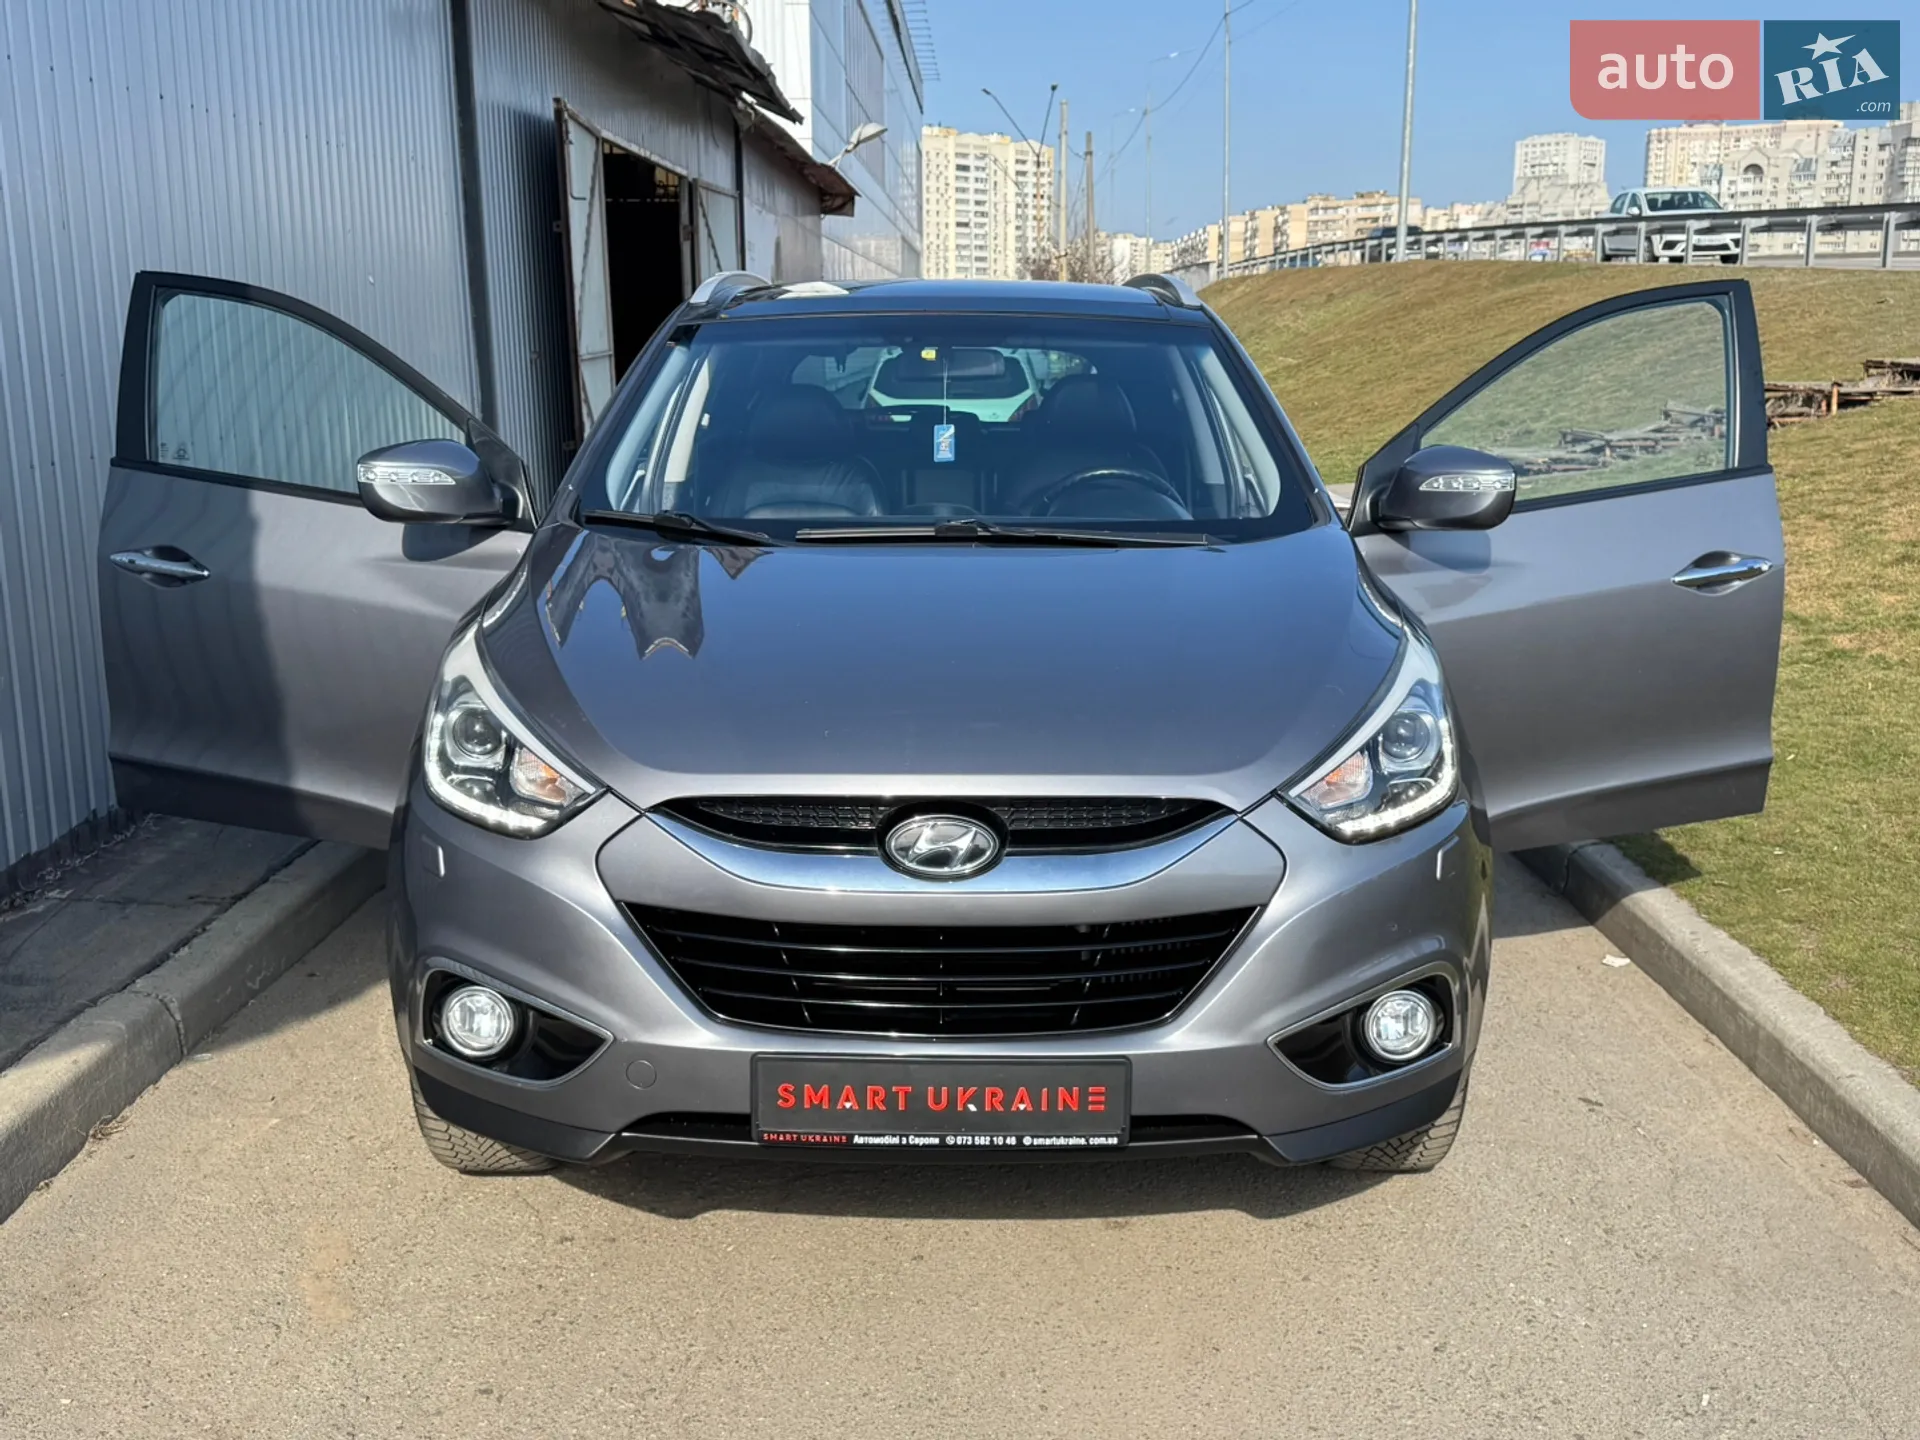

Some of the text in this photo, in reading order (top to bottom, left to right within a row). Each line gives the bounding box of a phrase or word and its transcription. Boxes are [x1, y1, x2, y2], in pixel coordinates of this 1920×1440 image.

[776, 1082, 1106, 1112] SMART UKRAINE
[763, 1133, 847, 1143] SMART UKRAINE
[956, 1135, 973, 1146] 073
[992, 1136, 1004, 1146] 10
